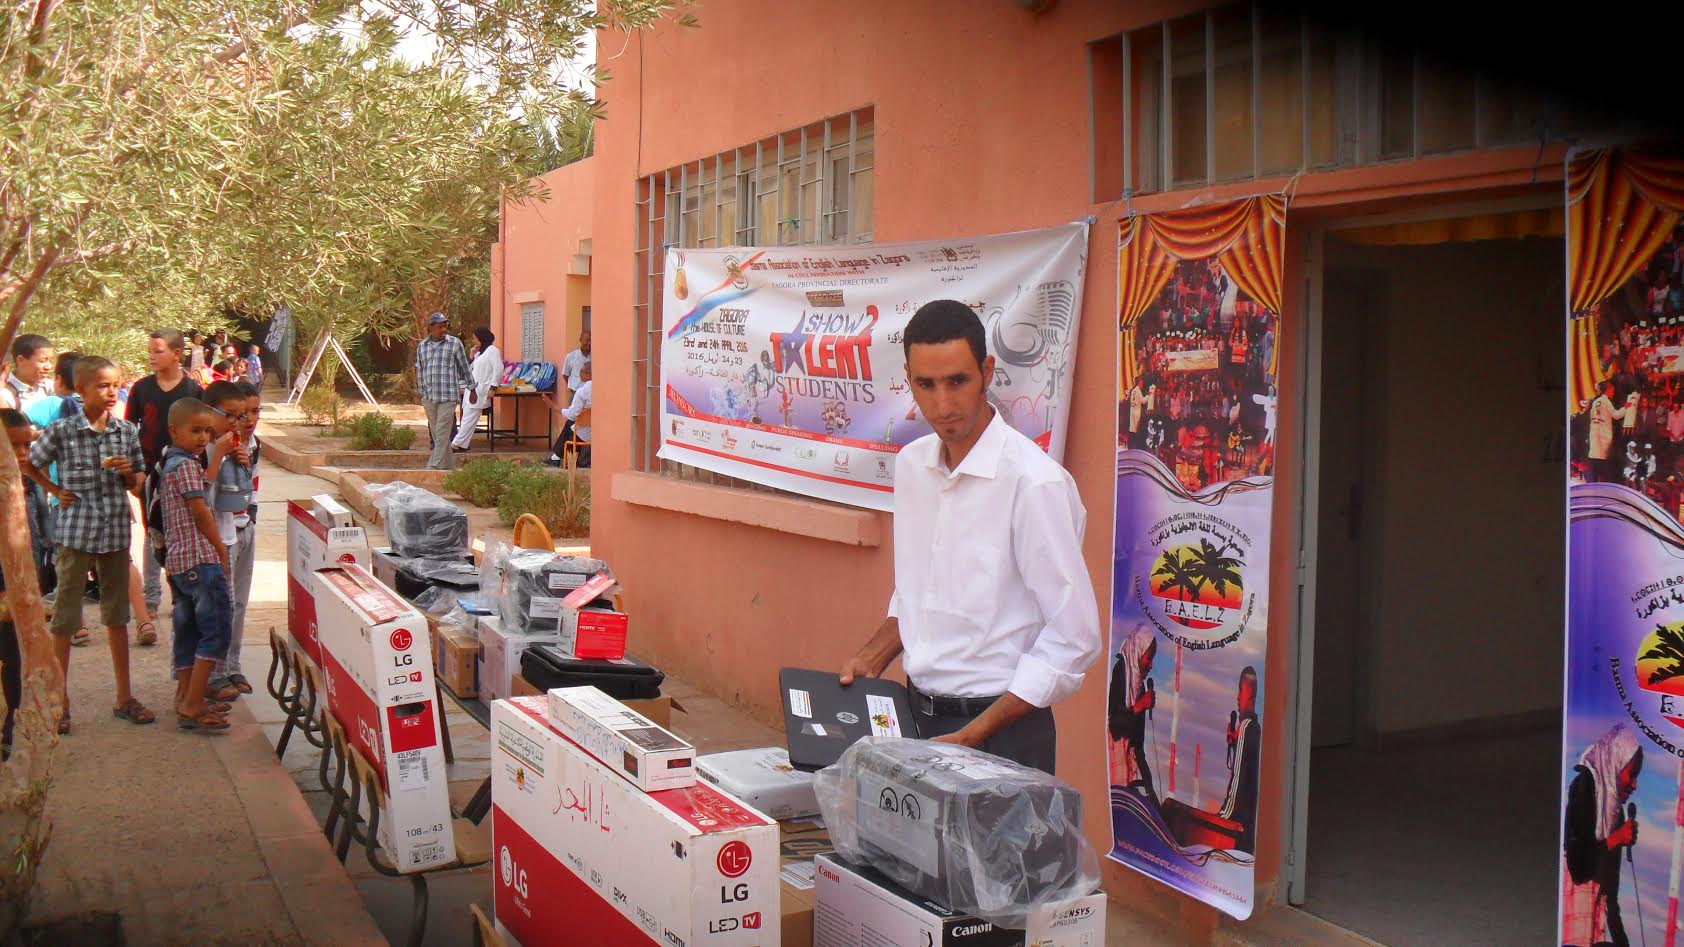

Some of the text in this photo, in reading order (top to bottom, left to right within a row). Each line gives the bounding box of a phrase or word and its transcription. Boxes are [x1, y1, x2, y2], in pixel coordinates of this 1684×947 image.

[839, 277, 888, 286] DIRECTORATE
[720, 308, 749, 323] ZAGORA
[805, 305, 879, 336] SHOW 2
[723, 324, 746, 336] CULTURE
[776, 376, 876, 404] STUDENTS
[1144, 606, 1175, 642] Association
[1174, 636, 1184, 646] of
[1183, 637, 1207, 652] English
[1206, 629, 1241, 651] Language
[394, 654, 413, 668] LG
[388, 674, 408, 687] LED
[1610, 656, 1627, 702] Basma
[1624, 701, 1676, 755] Association
[406, 827, 423, 838] 108
[513, 861, 529, 900] LG
[818, 865, 840, 884] Canon
[720, 883, 750, 904] LG
[709, 914, 758, 934] LED TV
[951, 923, 993, 938] Canon
